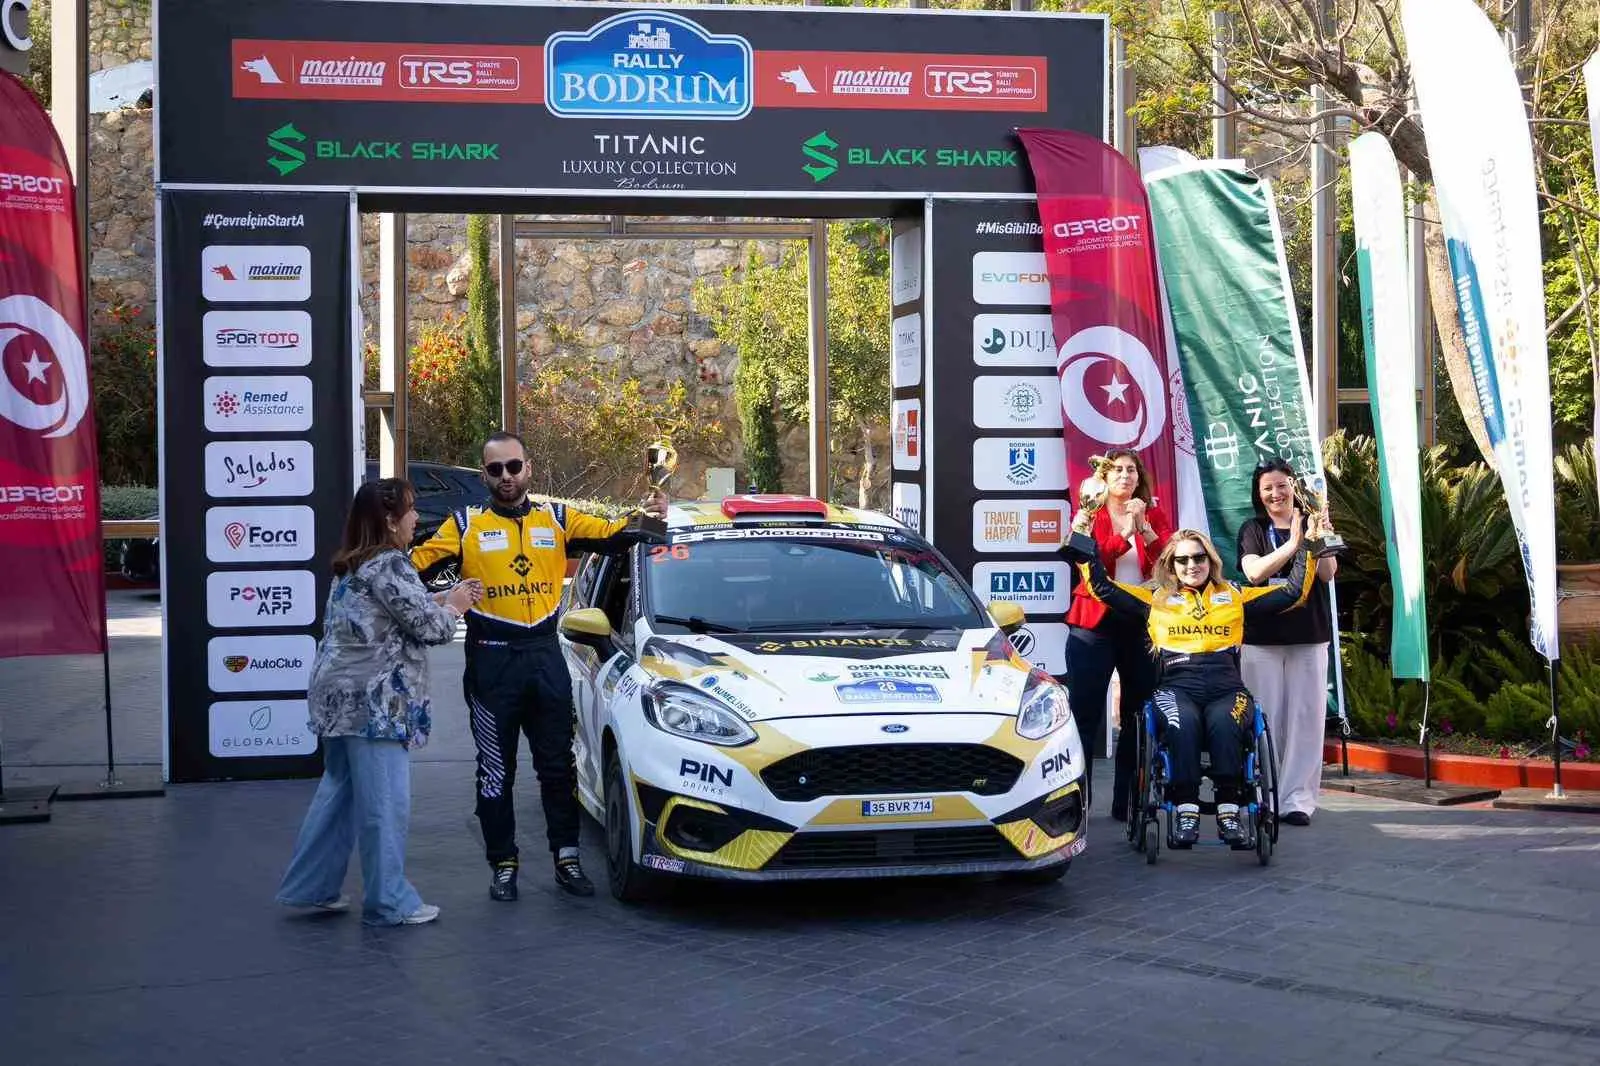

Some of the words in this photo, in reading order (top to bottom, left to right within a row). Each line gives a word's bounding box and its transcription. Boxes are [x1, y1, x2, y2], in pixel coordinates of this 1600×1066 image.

[300, 56, 386, 77] maxima
[613, 53, 685, 69] RALLY
[402, 61, 473, 85] TRS
[832, 65, 913, 87] maxima
[559, 71, 739, 104] BODRUM
[928, 70, 993, 95] TRS
[316, 140, 401, 159] BLACK
[411, 143, 500, 160] SHARK
[593, 134, 705, 155] TITANIC
[848, 148, 927, 166] BLACK
[936, 149, 1017, 168] SHARK
[562, 160, 626, 175] LUXURY
[630, 161, 737, 176] COLLECTION
[614, 177, 686, 189] Bodrum
[203, 211, 305, 229] #ÇevreİçinStartA
[248, 262, 302, 276] maxima
[216, 333, 257, 344] SPOR
[258, 332, 300, 344] TOTO
[243, 391, 288, 402] Remed
[1257, 334, 1294, 463] COLLECTION
[243, 404, 304, 415] Assistance
[223, 451, 295, 484] Salados
[984, 511, 1021, 525] TRAVEL
[1031, 519, 1057, 529] ato
[249, 526, 297, 543] Fora
[750, 530, 879, 540] Motorsport
[985, 526, 1020, 540] HAPPY
[649, 543, 689, 563] 26
[487, 581, 553, 599] BINANCE
[994, 575, 1051, 591] TAV
[230, 586, 292, 601] POWER
[257, 601, 292, 615] APP
[1168, 625, 1231, 637] BINANCE
[791, 638, 913, 648] BINANCE
[249, 657, 303, 669] AutoClub
[1040, 748, 1072, 779] PIN
[679, 758, 734, 787] PIN
[872, 803, 885, 813] 35
[888, 802, 910, 812] BVR
[913, 801, 931, 811] 714
